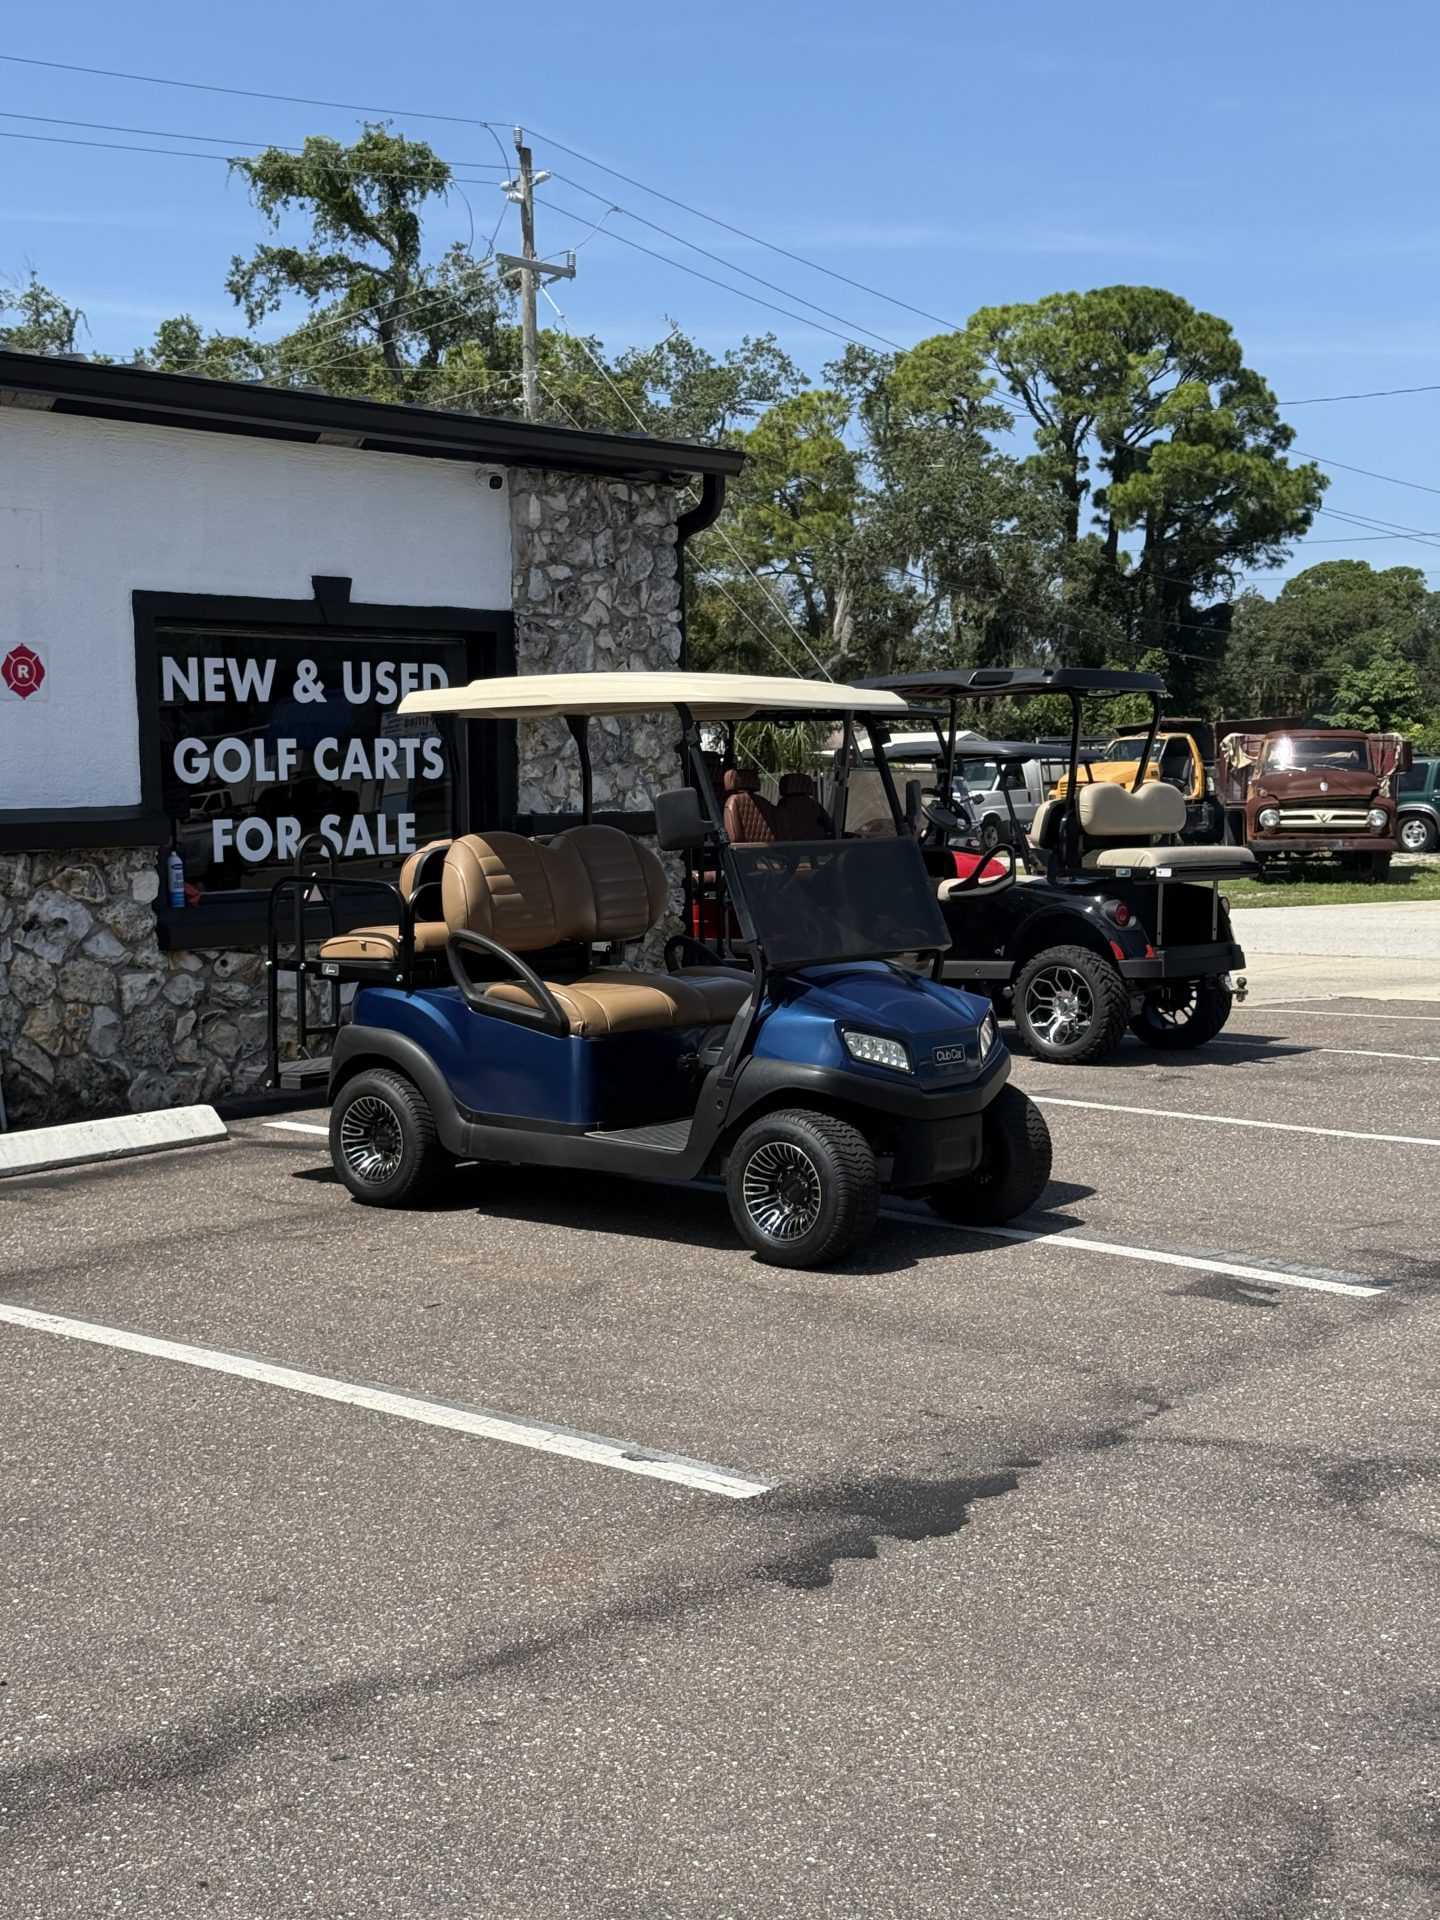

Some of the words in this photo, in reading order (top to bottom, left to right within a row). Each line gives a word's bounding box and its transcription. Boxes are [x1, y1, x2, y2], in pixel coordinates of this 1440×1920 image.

[17, 664, 30, 679] R
[161, 656, 277, 702] NEW
[293, 659, 327, 704] &
[342, 661, 449, 705] USED
[173, 737, 297, 784] GOLF
[313, 737, 444, 782] CARTS
[212, 816, 302, 863] FOR
[320, 813, 417, 858] SALE
